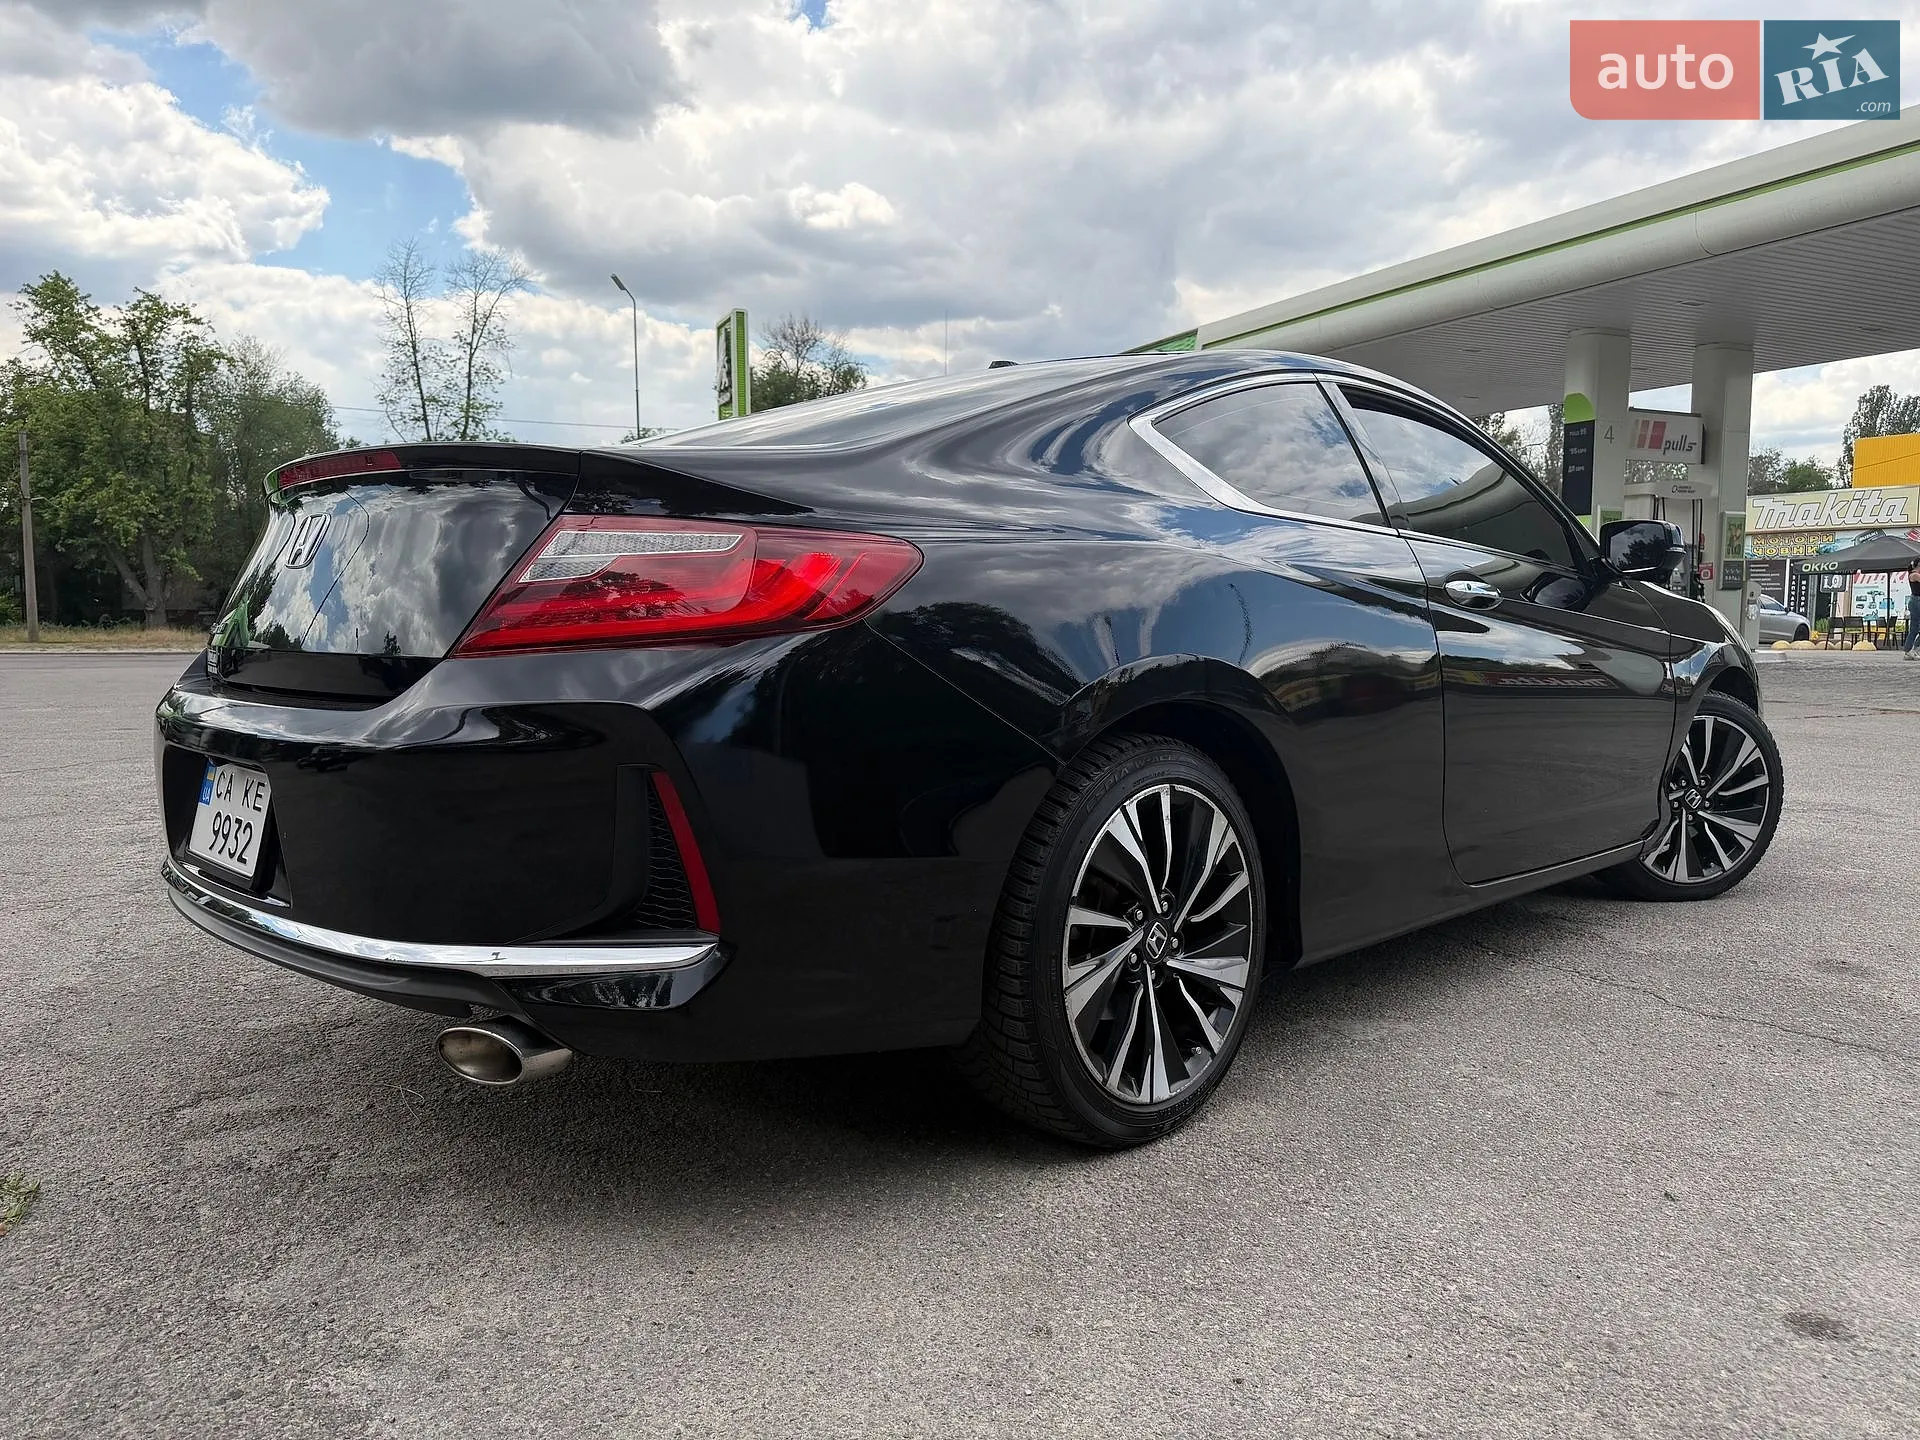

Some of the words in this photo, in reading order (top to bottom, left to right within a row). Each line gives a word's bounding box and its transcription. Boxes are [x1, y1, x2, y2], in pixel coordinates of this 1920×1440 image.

[1604, 426, 1614, 444] 4
[1663, 435, 1696, 454] pulls
[1753, 533, 1834, 546] МОТОРИ
[1753, 545, 1818, 556] ЧОВНИ
[1802, 562, 1839, 573] OKKO
[216, 770, 235, 802] CA
[242, 777, 267, 812] KE
[209, 812, 252, 864] 9932
